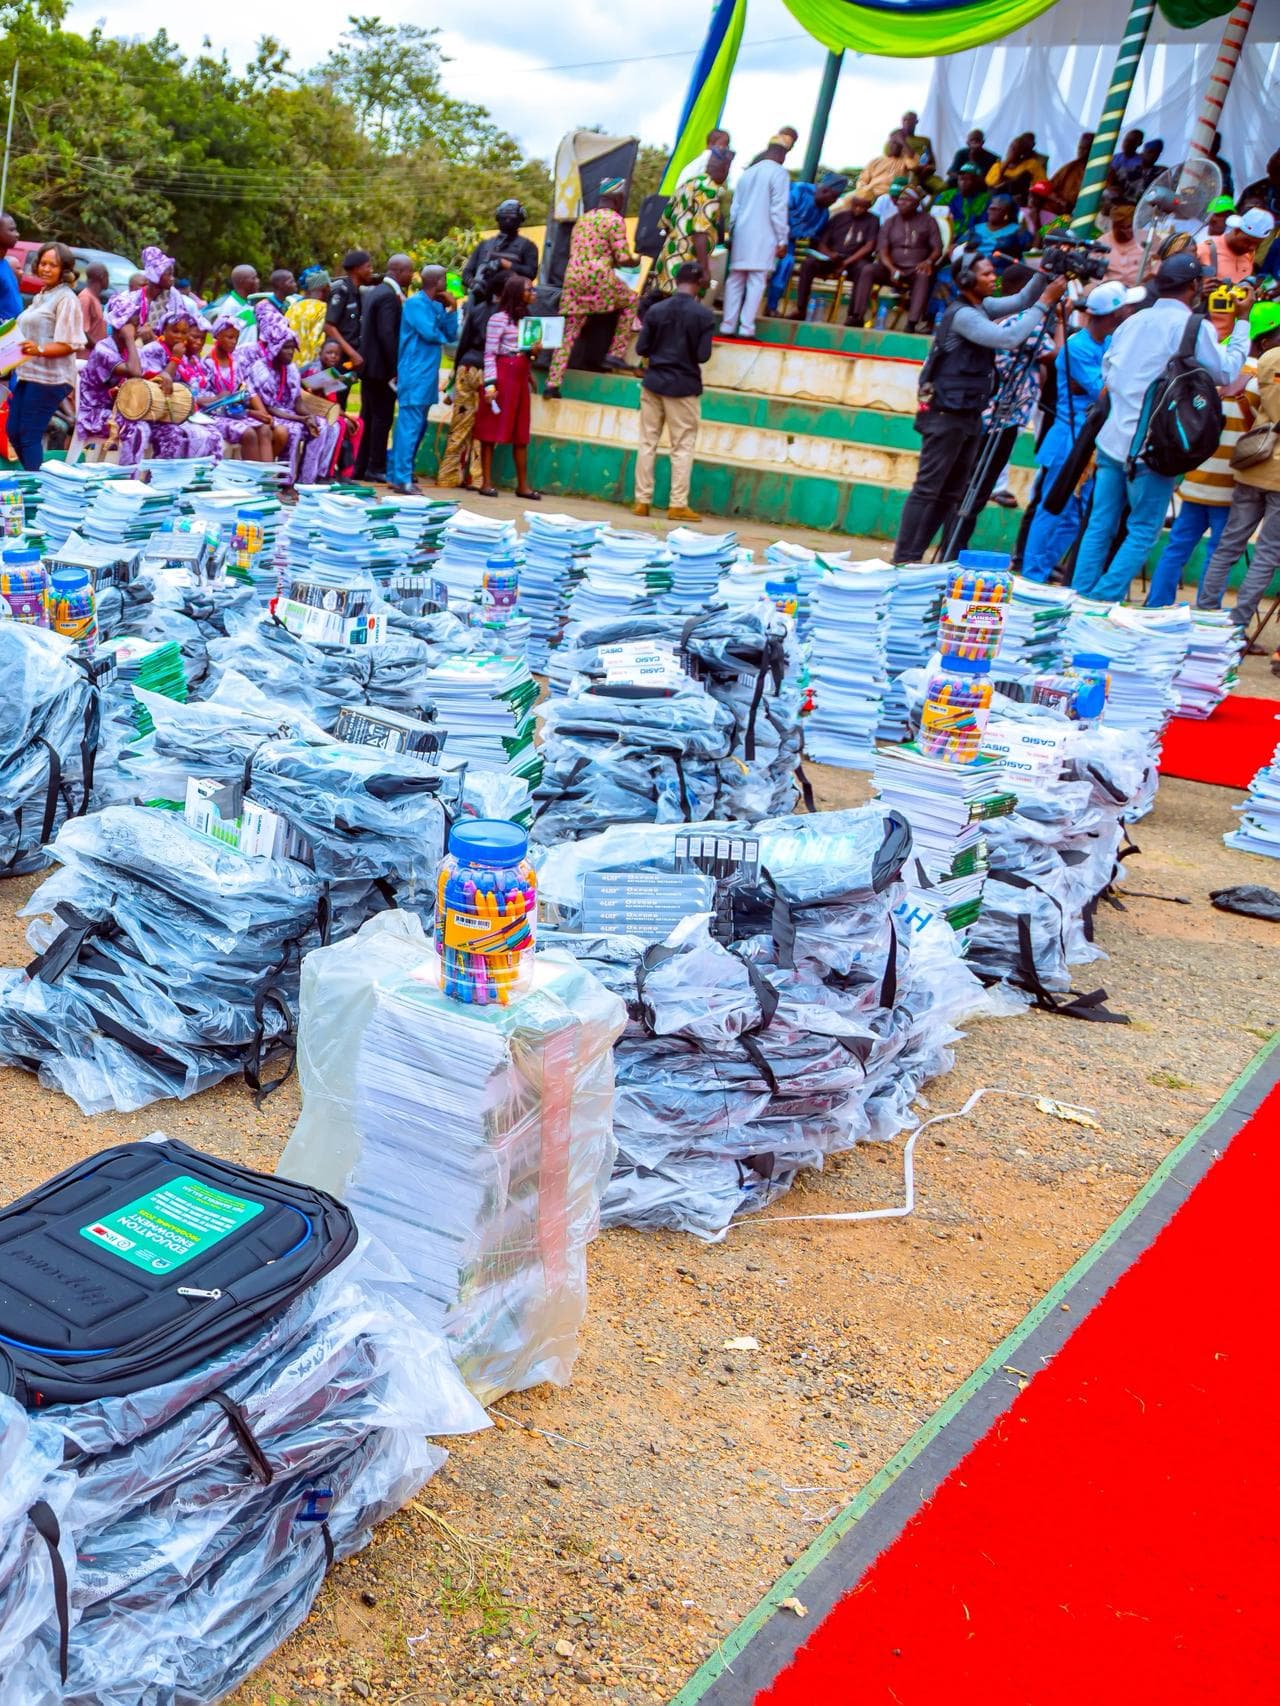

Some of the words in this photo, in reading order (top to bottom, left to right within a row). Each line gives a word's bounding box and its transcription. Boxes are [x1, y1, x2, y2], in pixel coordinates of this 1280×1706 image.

[1022, 736, 1056, 747] CASIO
[999, 759, 1032, 770] CASIO
[115, 1216, 189, 1254] EDUCATION
[127, 1213, 195, 1247] ENDOWMENT
